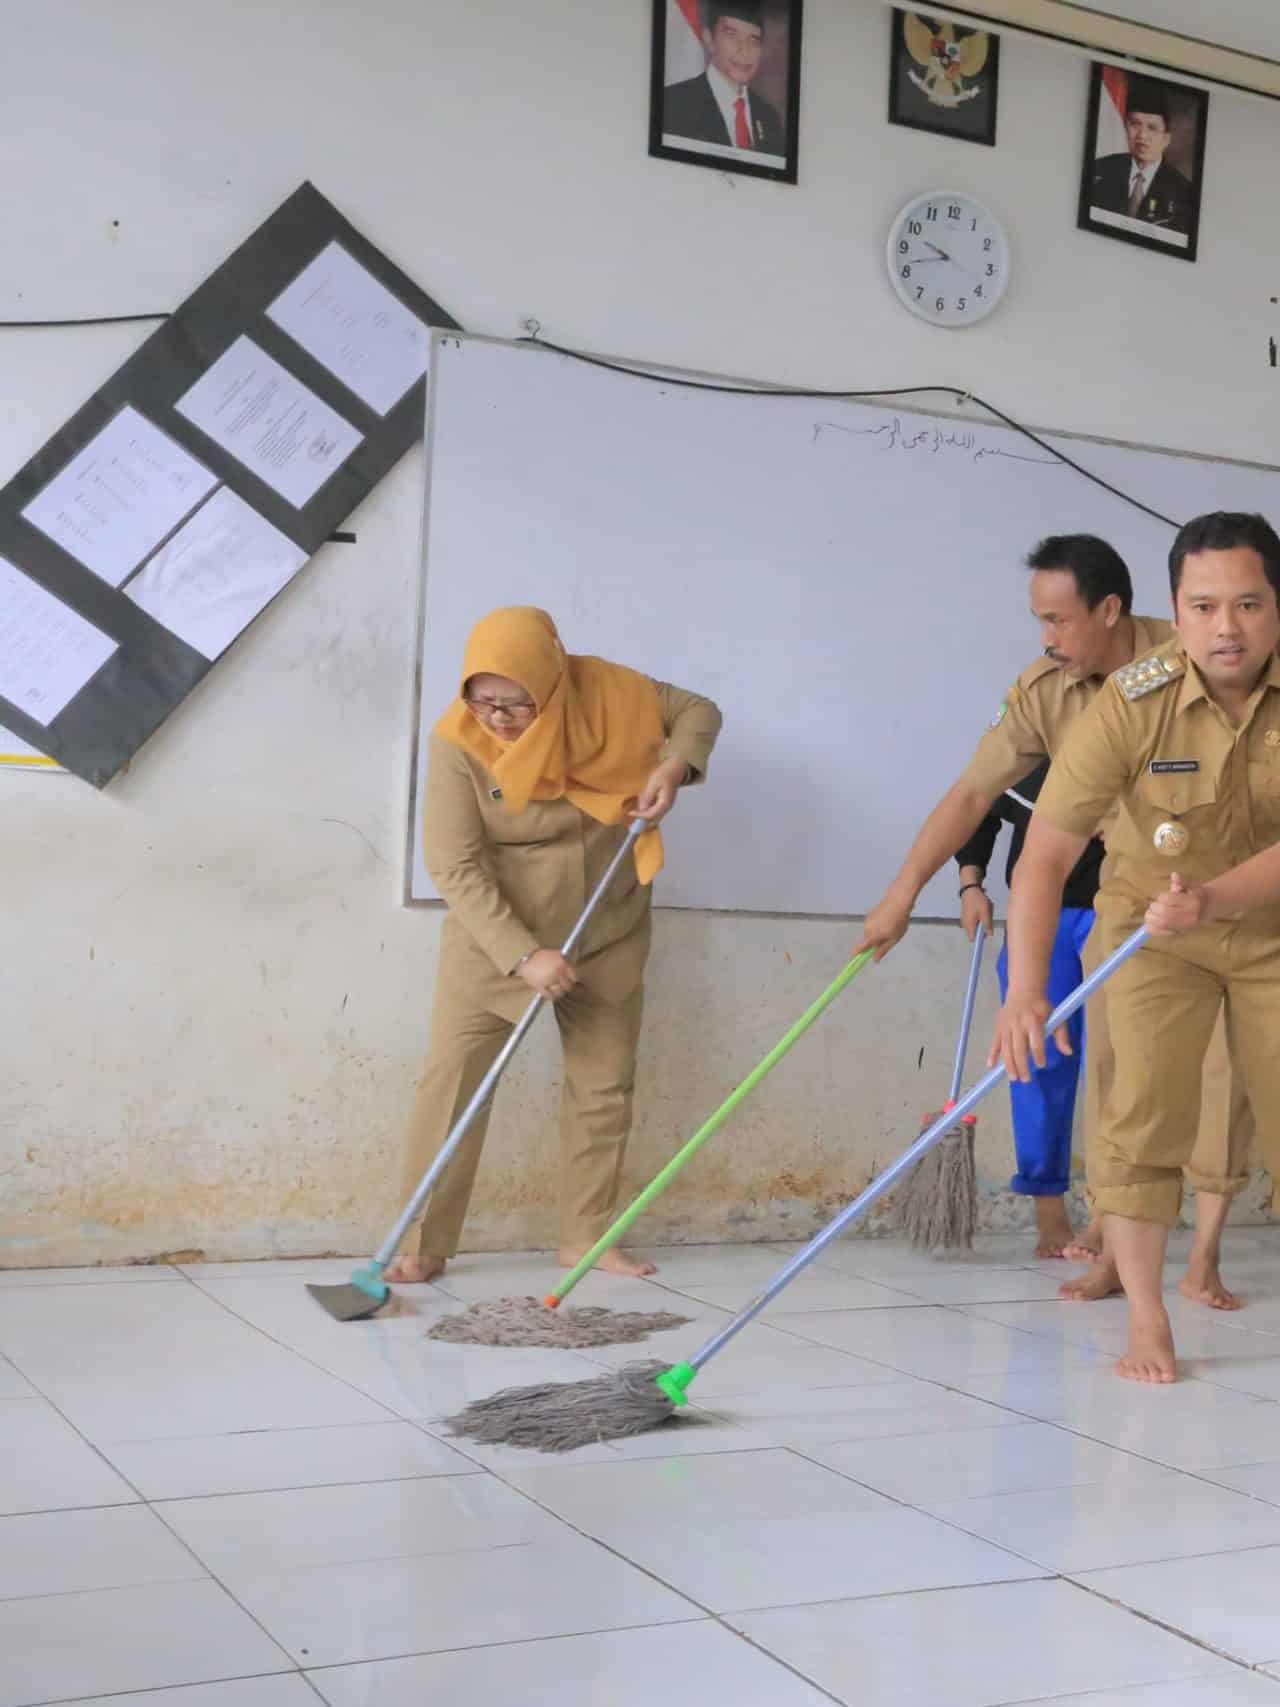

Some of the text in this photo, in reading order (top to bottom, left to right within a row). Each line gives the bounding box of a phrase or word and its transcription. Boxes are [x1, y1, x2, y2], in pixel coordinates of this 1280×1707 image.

[926, 206, 938, 221] 11
[947, 205, 961, 220] 12
[907, 221, 922, 236] 10
[970, 218, 977, 231] 1
[899, 240, 909, 254] 9
[983, 238, 991, 251] 2
[901, 264, 911, 278] 8
[985, 263, 994, 276] 3
[915, 286, 924, 299] 7
[973, 284, 983, 297] 4
[935, 297, 945, 311] 6
[956, 297, 967, 311] 5
